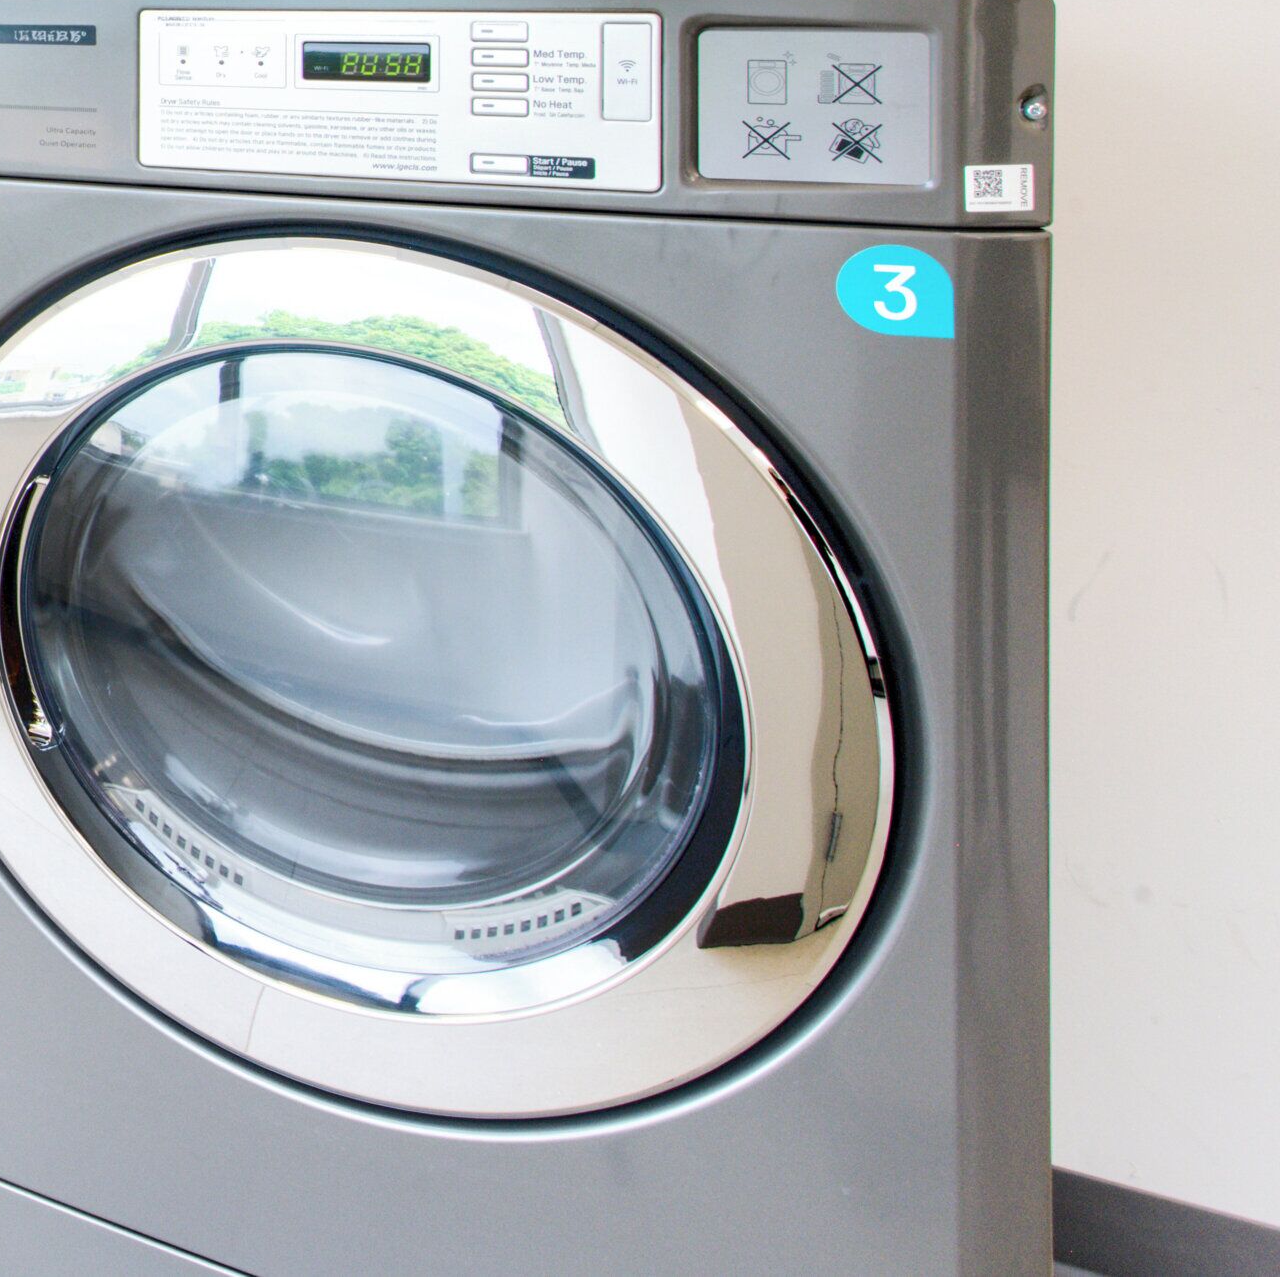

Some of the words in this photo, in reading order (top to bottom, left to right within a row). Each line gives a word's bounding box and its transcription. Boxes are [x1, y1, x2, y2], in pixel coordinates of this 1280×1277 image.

[533, 49, 554, 59] Med
[532, 74, 554, 84] Low
[178, 98, 201, 108] Safety
[532, 100, 546, 109] No
[549, 100, 573, 110] Heat
[46, 126, 64, 134] Ultra
[65, 126, 96, 136] Capacity
[39, 138, 58, 146] Quiet
[60, 140, 96, 148] Operation
[533, 156, 554, 166] Start
[562, 158, 588, 167] Pause
[1020, 167, 1028, 208] REMOVE
[874, 265, 917, 320] 3
